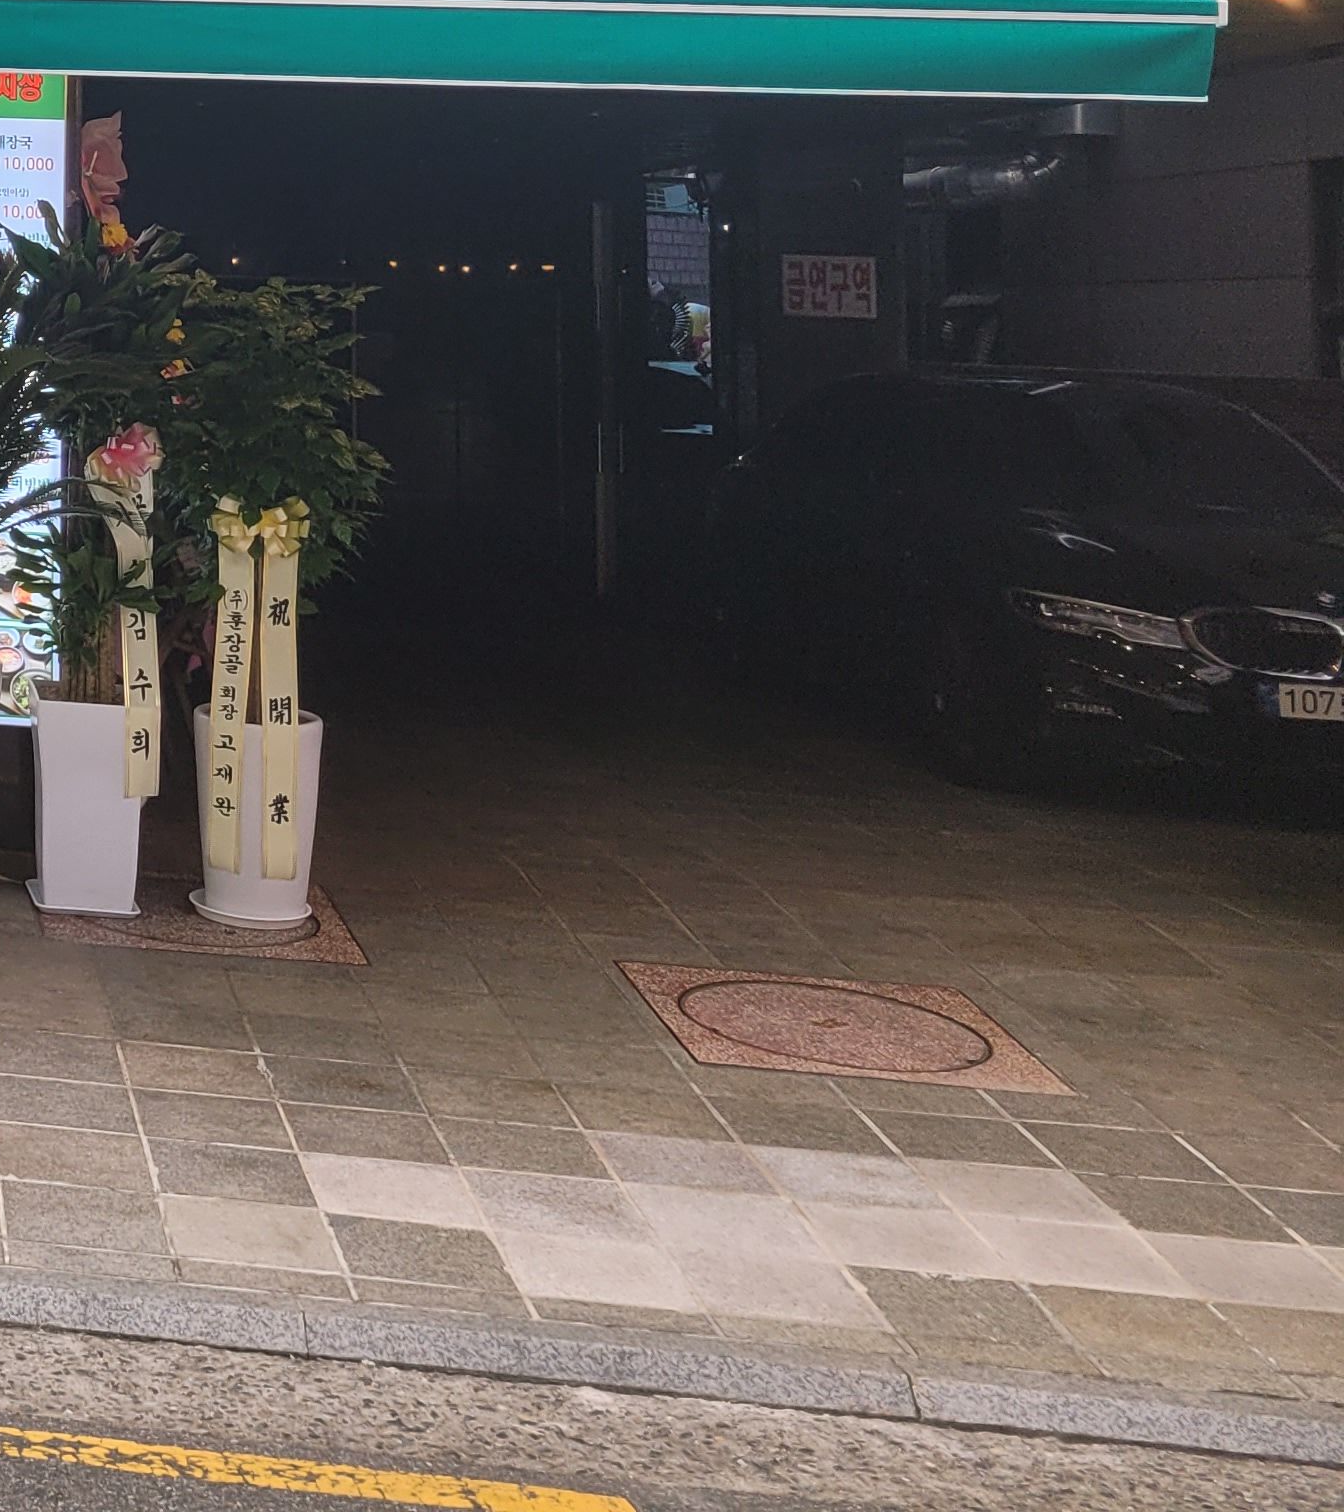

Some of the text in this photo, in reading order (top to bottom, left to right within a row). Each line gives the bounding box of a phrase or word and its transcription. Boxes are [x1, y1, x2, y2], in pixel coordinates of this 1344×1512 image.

[3, 157, 54, 172] 10,000
[3, 205, 44, 219] 10,00
[787, 261, 872, 313] 금연구역
[217, 687, 238, 722] 회장
[1285, 689, 1344, 715] 107
[212, 735, 236, 817] 고재완
